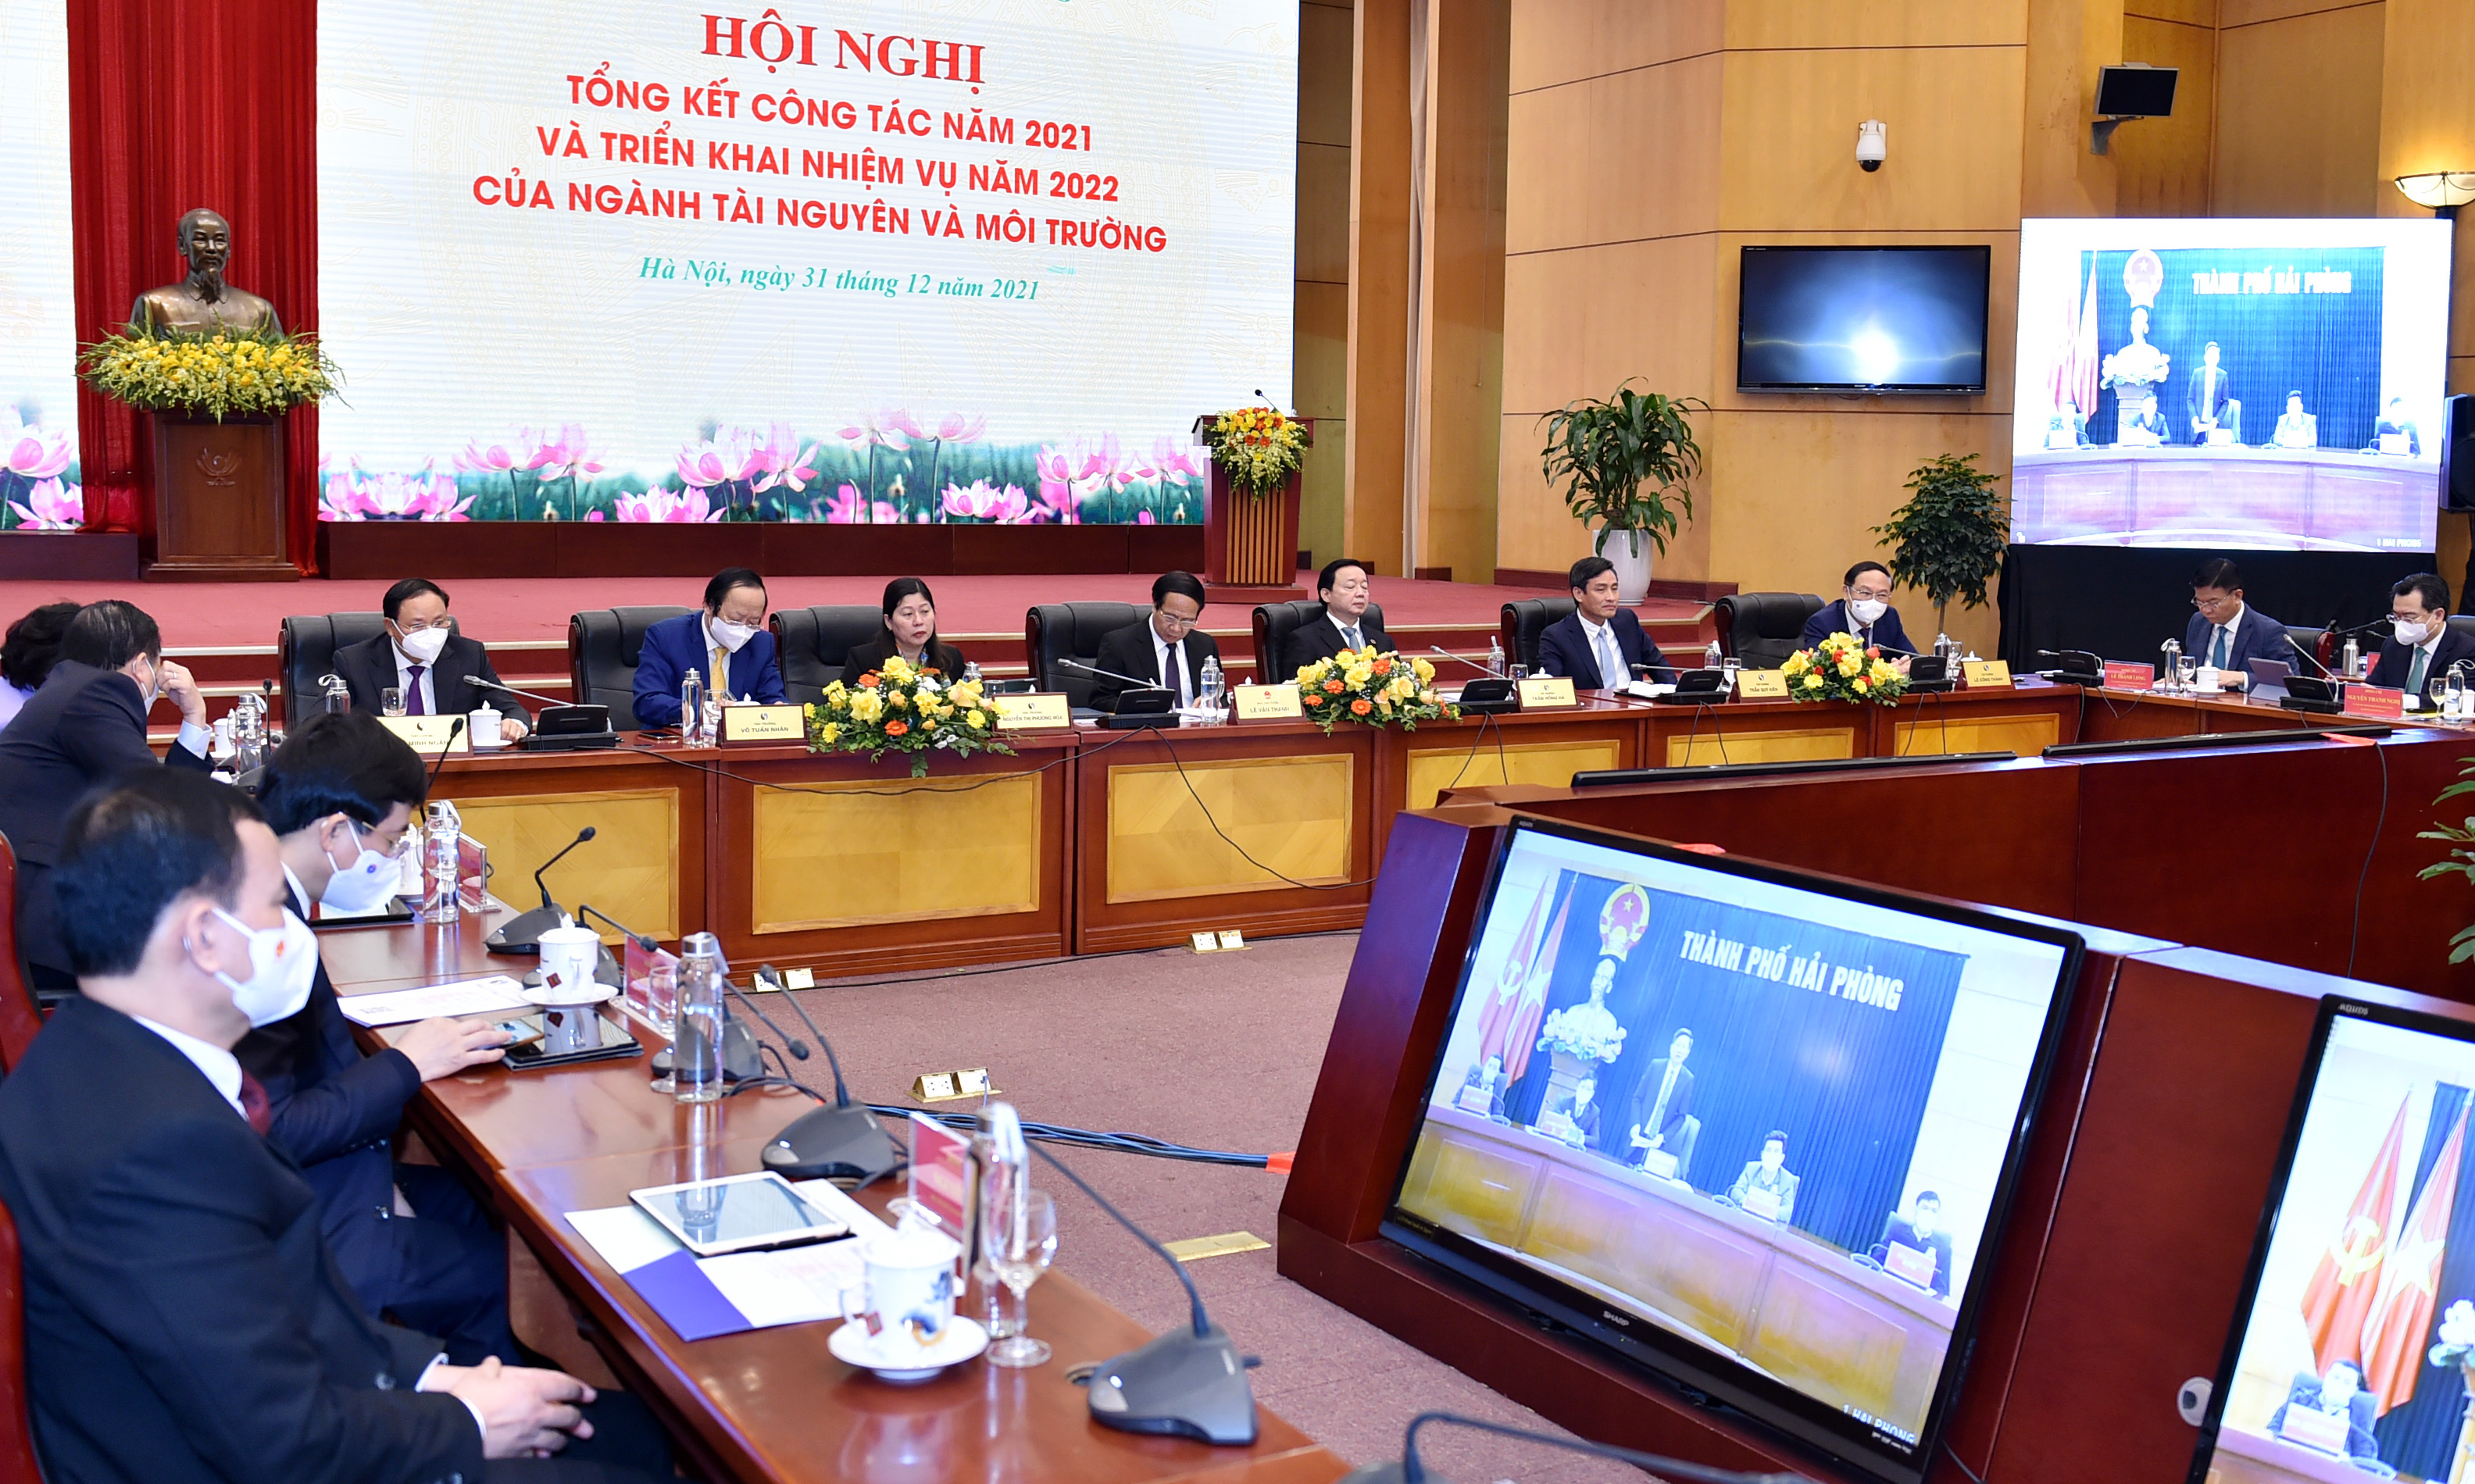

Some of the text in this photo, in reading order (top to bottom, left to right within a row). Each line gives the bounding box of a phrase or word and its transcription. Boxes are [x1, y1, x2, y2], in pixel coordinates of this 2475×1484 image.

[702, 8, 984, 95] HỘI NGHỊ
[566, 60, 1091, 152] TỔNG KẾT CÔNG TÁC NĂM 2021
[537, 120, 1119, 202] VÀ TRIỂN KHAI NHIỆM VỤ NĂM 2022
[473, 166, 1167, 253] CỦA NGÀNH TÀI NGUYÊN VÀ MÔI TRƯỜNG
[639, 256, 1039, 301] Hà Nội, ngày 31 tháng 12 năm 2021
[1680, 929, 1905, 1011] THÀNH PHỐ HẢI PHÒNG
[1602, 1310, 1630, 1326] SHARP
